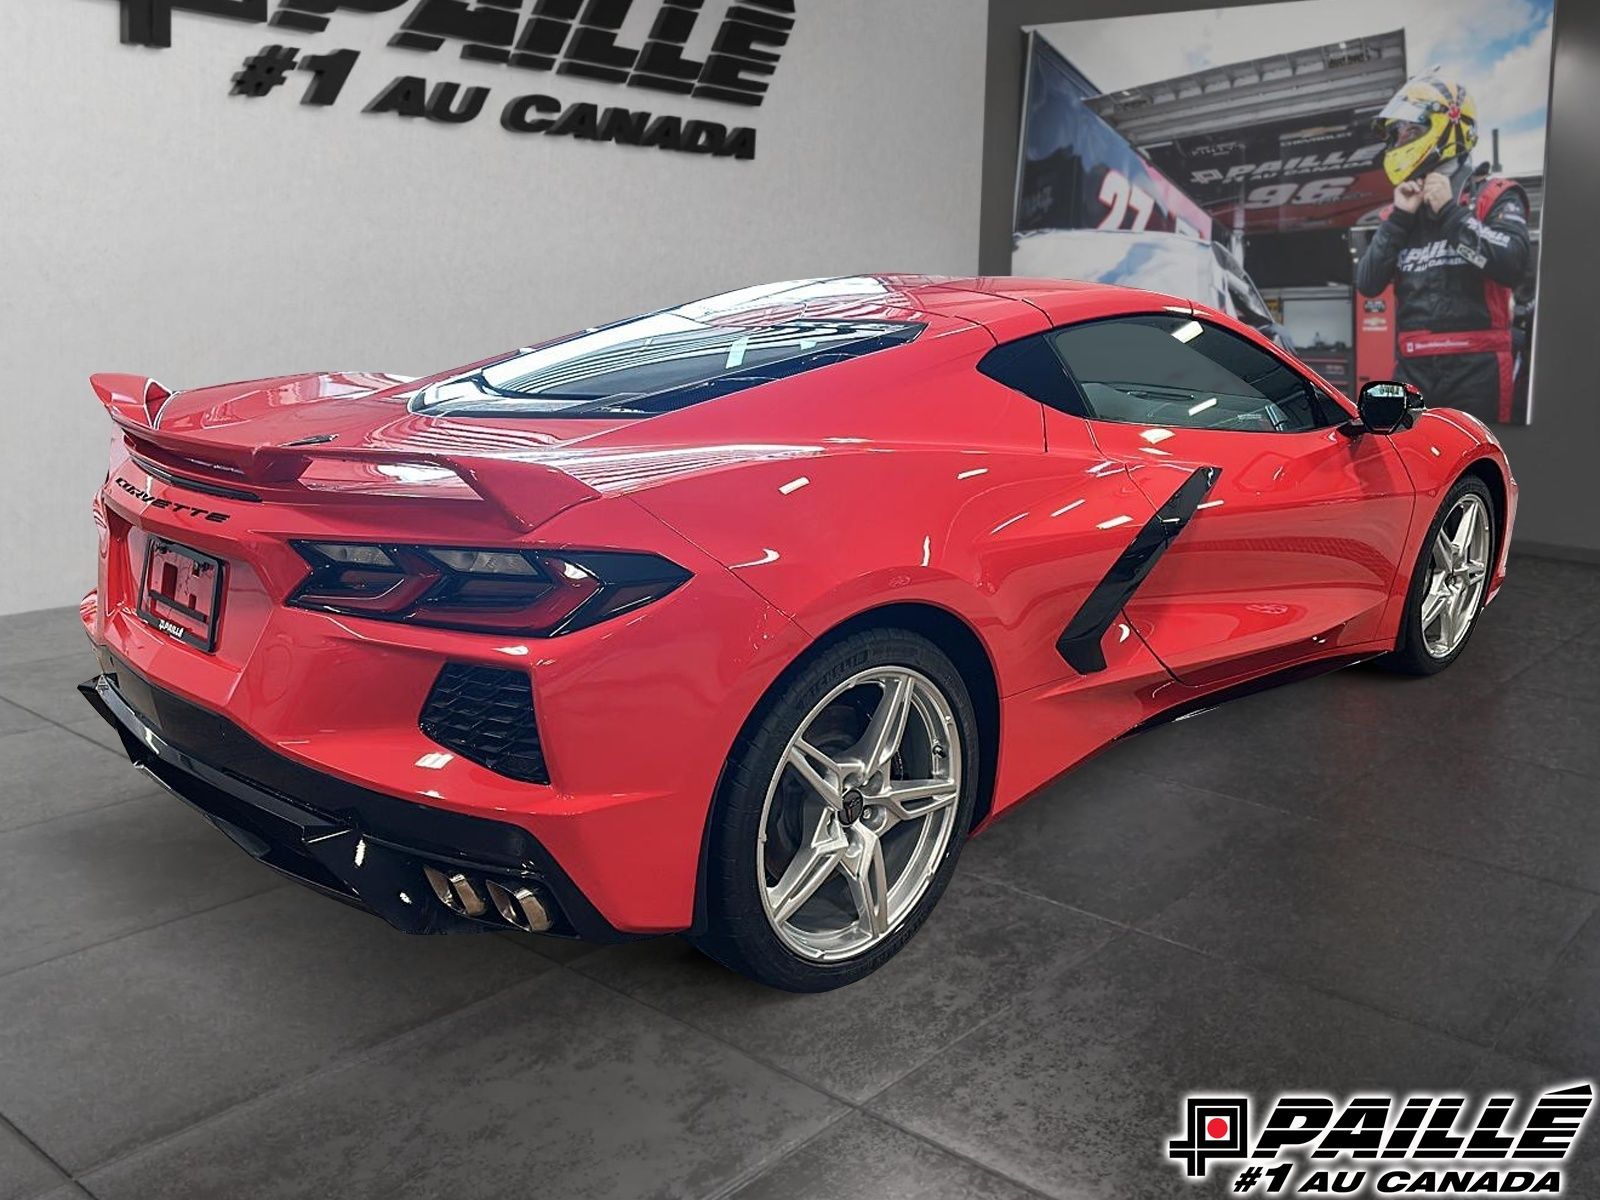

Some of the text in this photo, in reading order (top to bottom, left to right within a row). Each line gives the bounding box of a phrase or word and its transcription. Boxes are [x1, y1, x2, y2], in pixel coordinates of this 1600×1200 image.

[229, 45, 756, 160] #1 AU CANADA
[1284, 161, 1373, 177] CANADA
[1245, 176, 1354, 210] 96
[115, 477, 230, 523] CORVETTE
